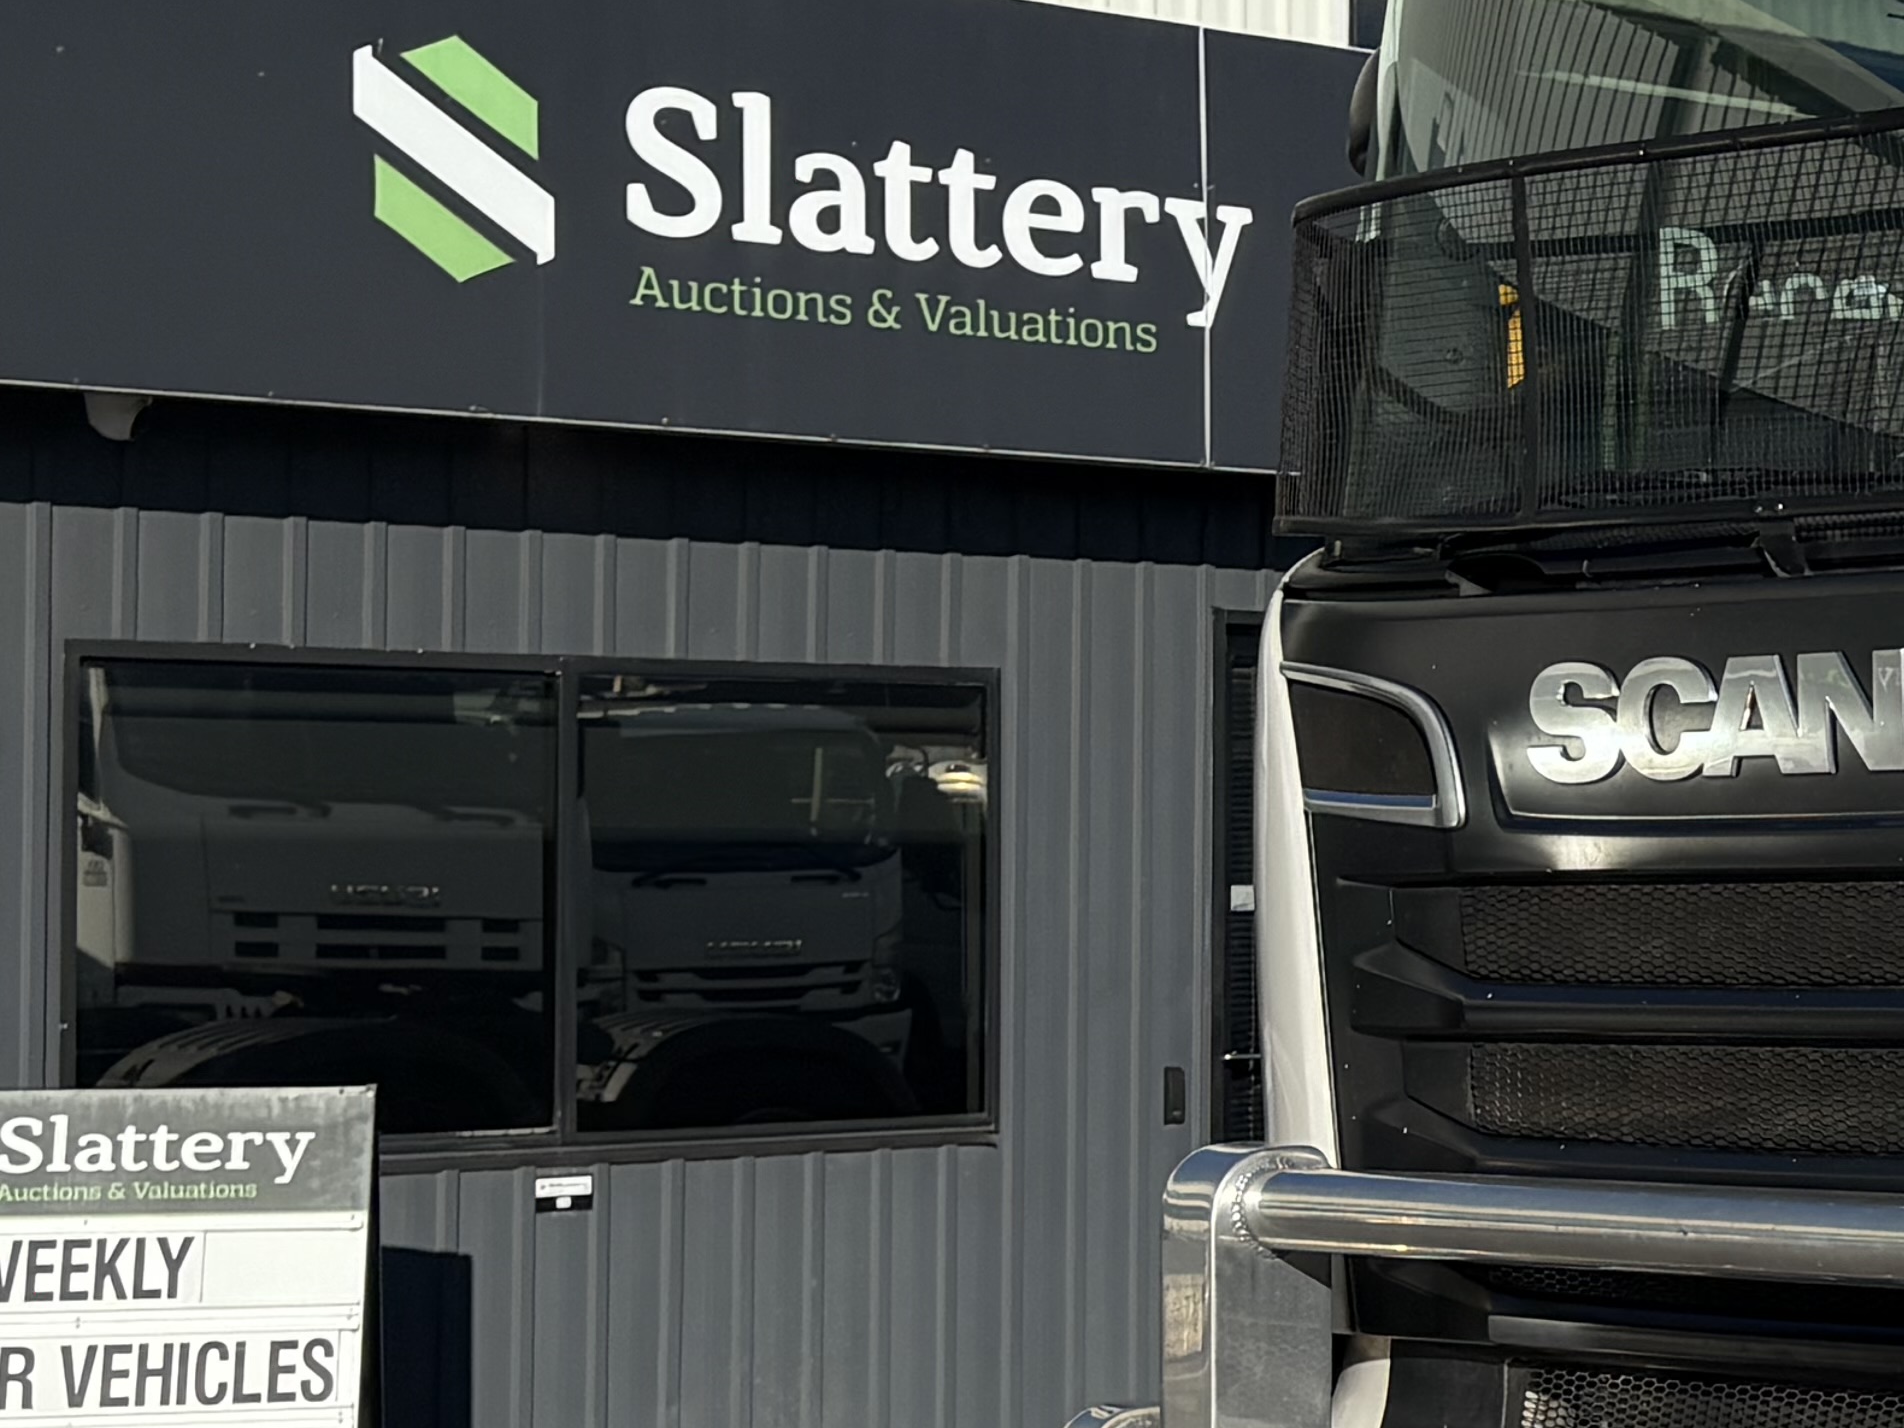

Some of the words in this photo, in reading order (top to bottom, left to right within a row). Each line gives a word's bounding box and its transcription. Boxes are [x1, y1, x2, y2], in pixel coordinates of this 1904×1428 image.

[625, 86, 1253, 328] Slattery
[629, 266, 852, 326] Auctions
[867, 289, 902, 329] &
[915, 293, 1158, 353] Valuations
[0, 1114, 316, 1184] Slattery
[0, 1181, 101, 1201] Auctions
[108, 1182, 126, 1200] &
[134, 1181, 258, 1200] Valuations
[60, 1338, 334, 1408] VEHICLES
